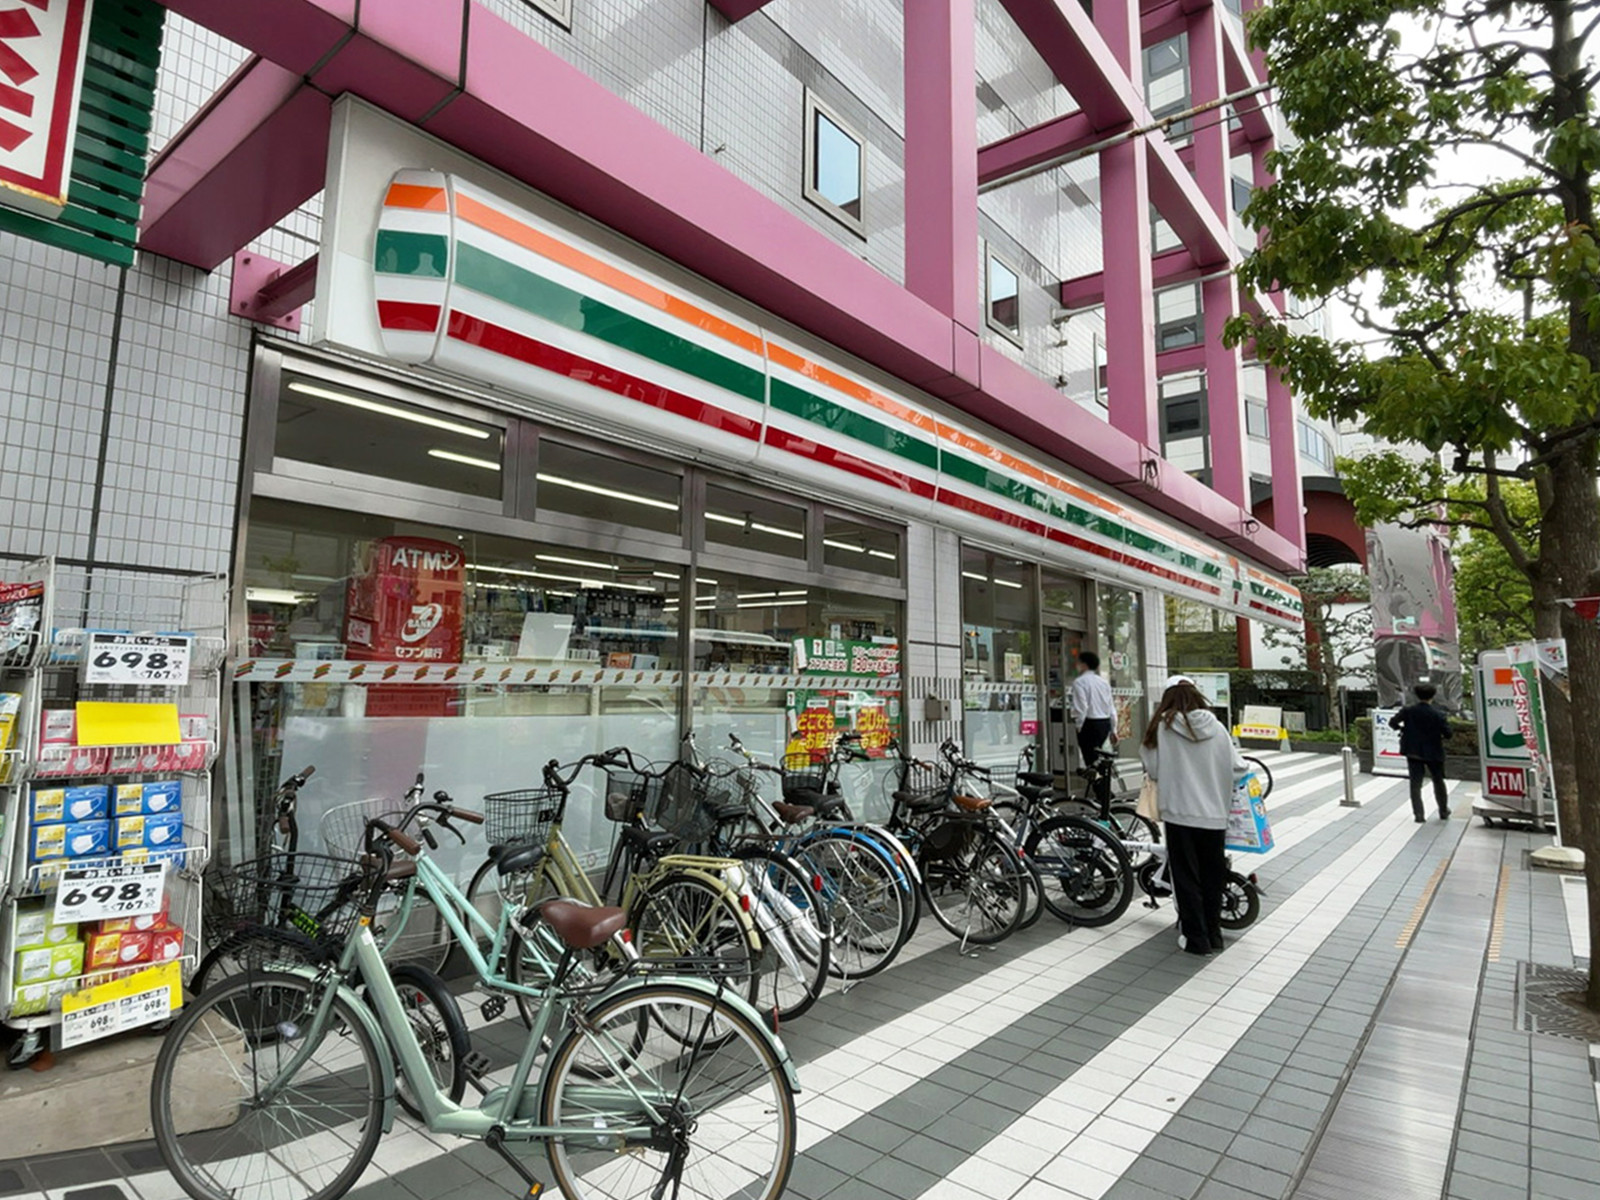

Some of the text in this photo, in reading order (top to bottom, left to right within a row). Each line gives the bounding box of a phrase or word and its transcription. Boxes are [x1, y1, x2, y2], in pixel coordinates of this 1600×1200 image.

[93, 651, 168, 669] 698
[395, 646, 442, 658] セブン銀行
[1491, 771, 1522, 791] ATM
[62, 883, 141, 906] 698
[144, 998, 161, 1011] 698
[90, 1015, 109, 1029] 698
